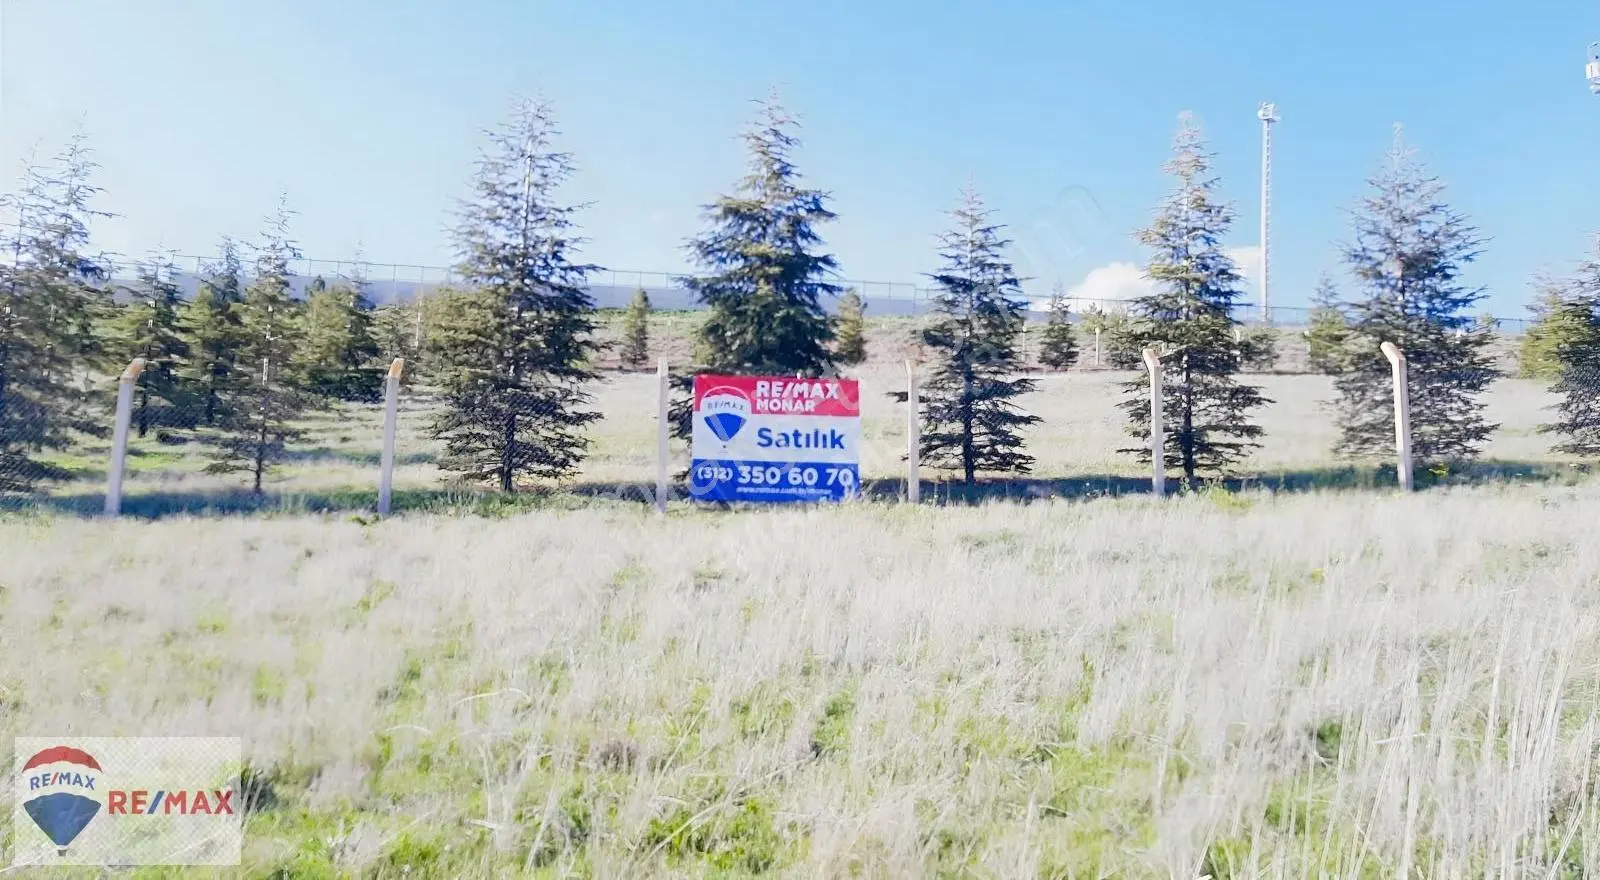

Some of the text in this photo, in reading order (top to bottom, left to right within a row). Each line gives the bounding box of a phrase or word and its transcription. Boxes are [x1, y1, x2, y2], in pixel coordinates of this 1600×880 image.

[756, 380, 840, 399] RE/MAX
[756, 399, 816, 412] MONAR
[757, 427, 845, 449] Satılık
[697, 465, 854, 487] (312) 350 60 70
